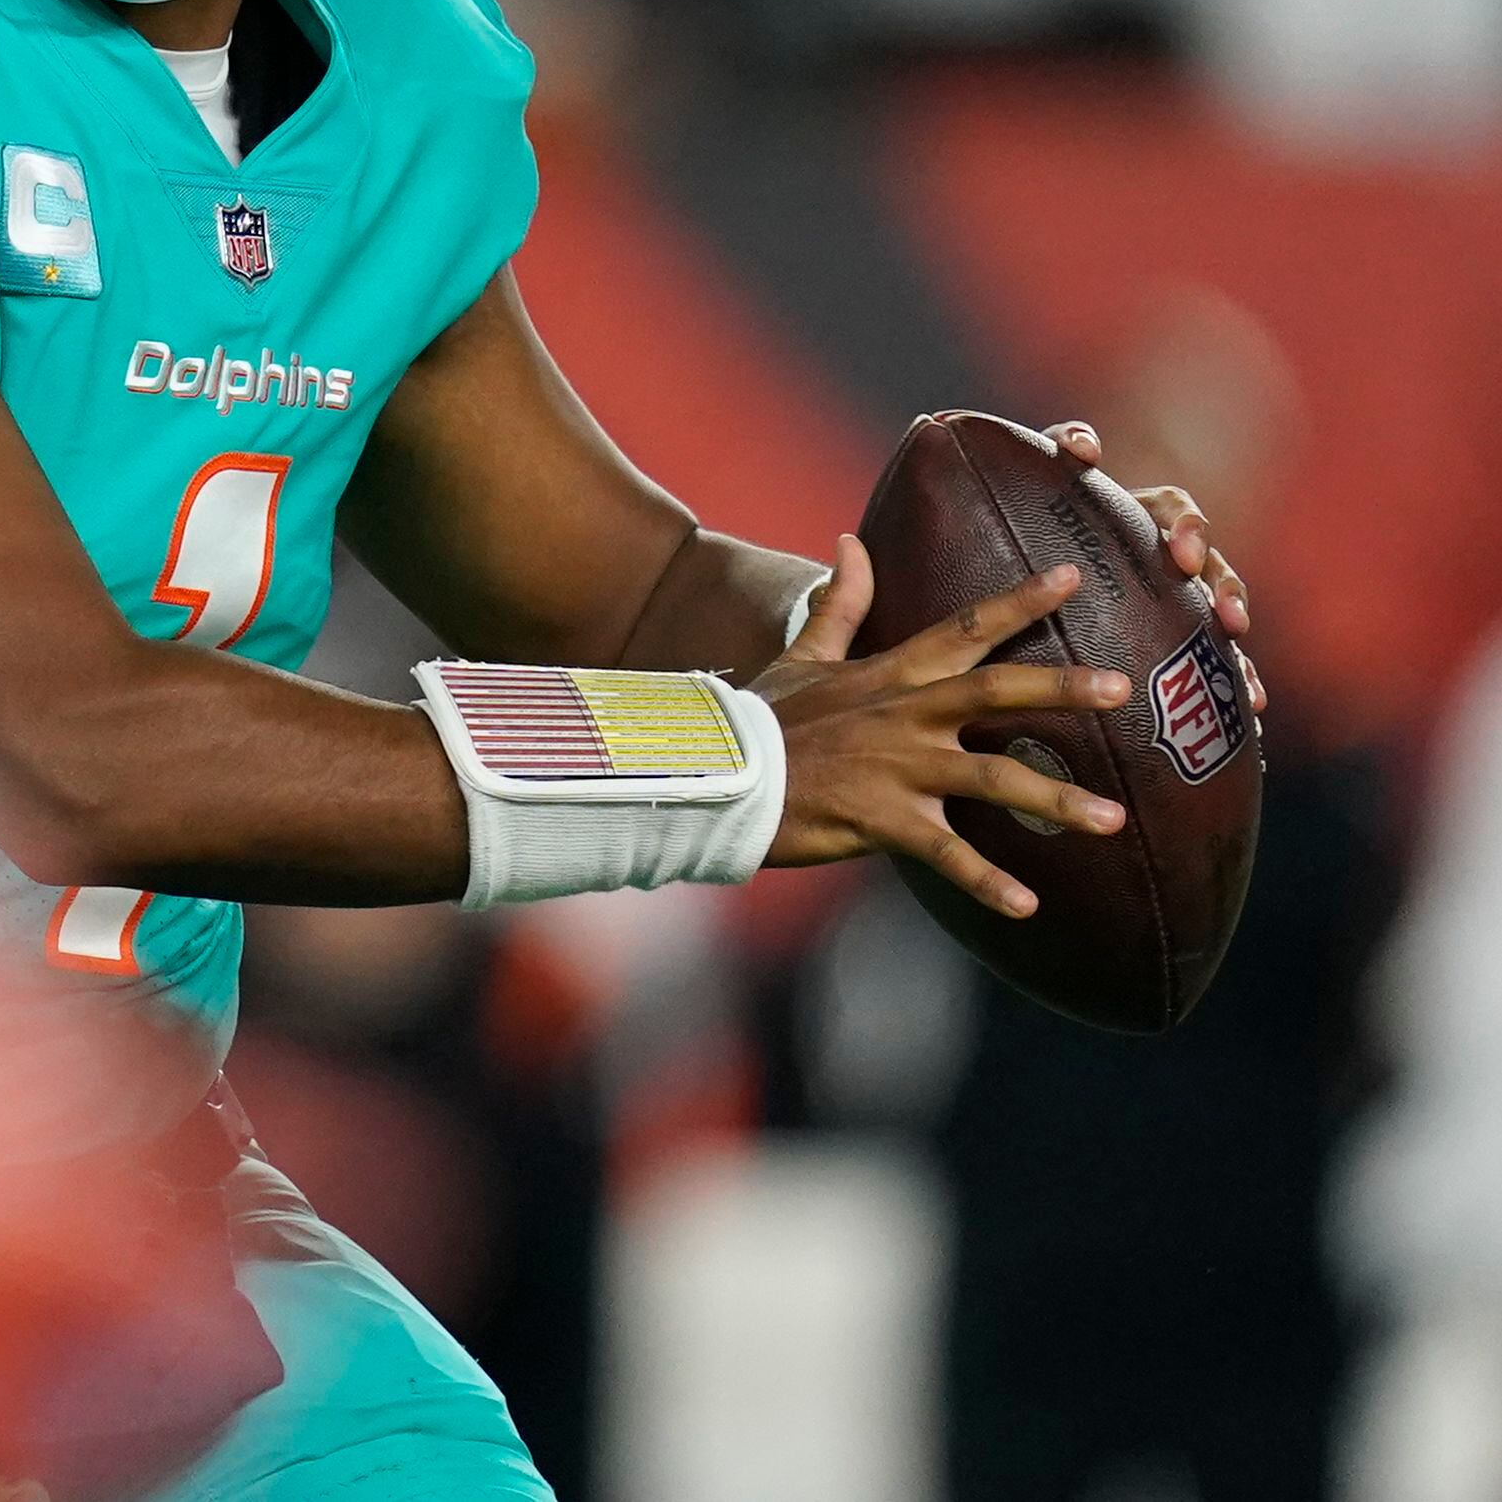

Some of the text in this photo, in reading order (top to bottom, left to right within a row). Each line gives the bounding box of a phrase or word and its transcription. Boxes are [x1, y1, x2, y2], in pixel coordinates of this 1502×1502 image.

[8, 151, 93, 255] C
[228, 237, 265, 272] NFL
[124, 339, 355, 415] Dolphins
[1161, 657, 1221, 769] NFL
